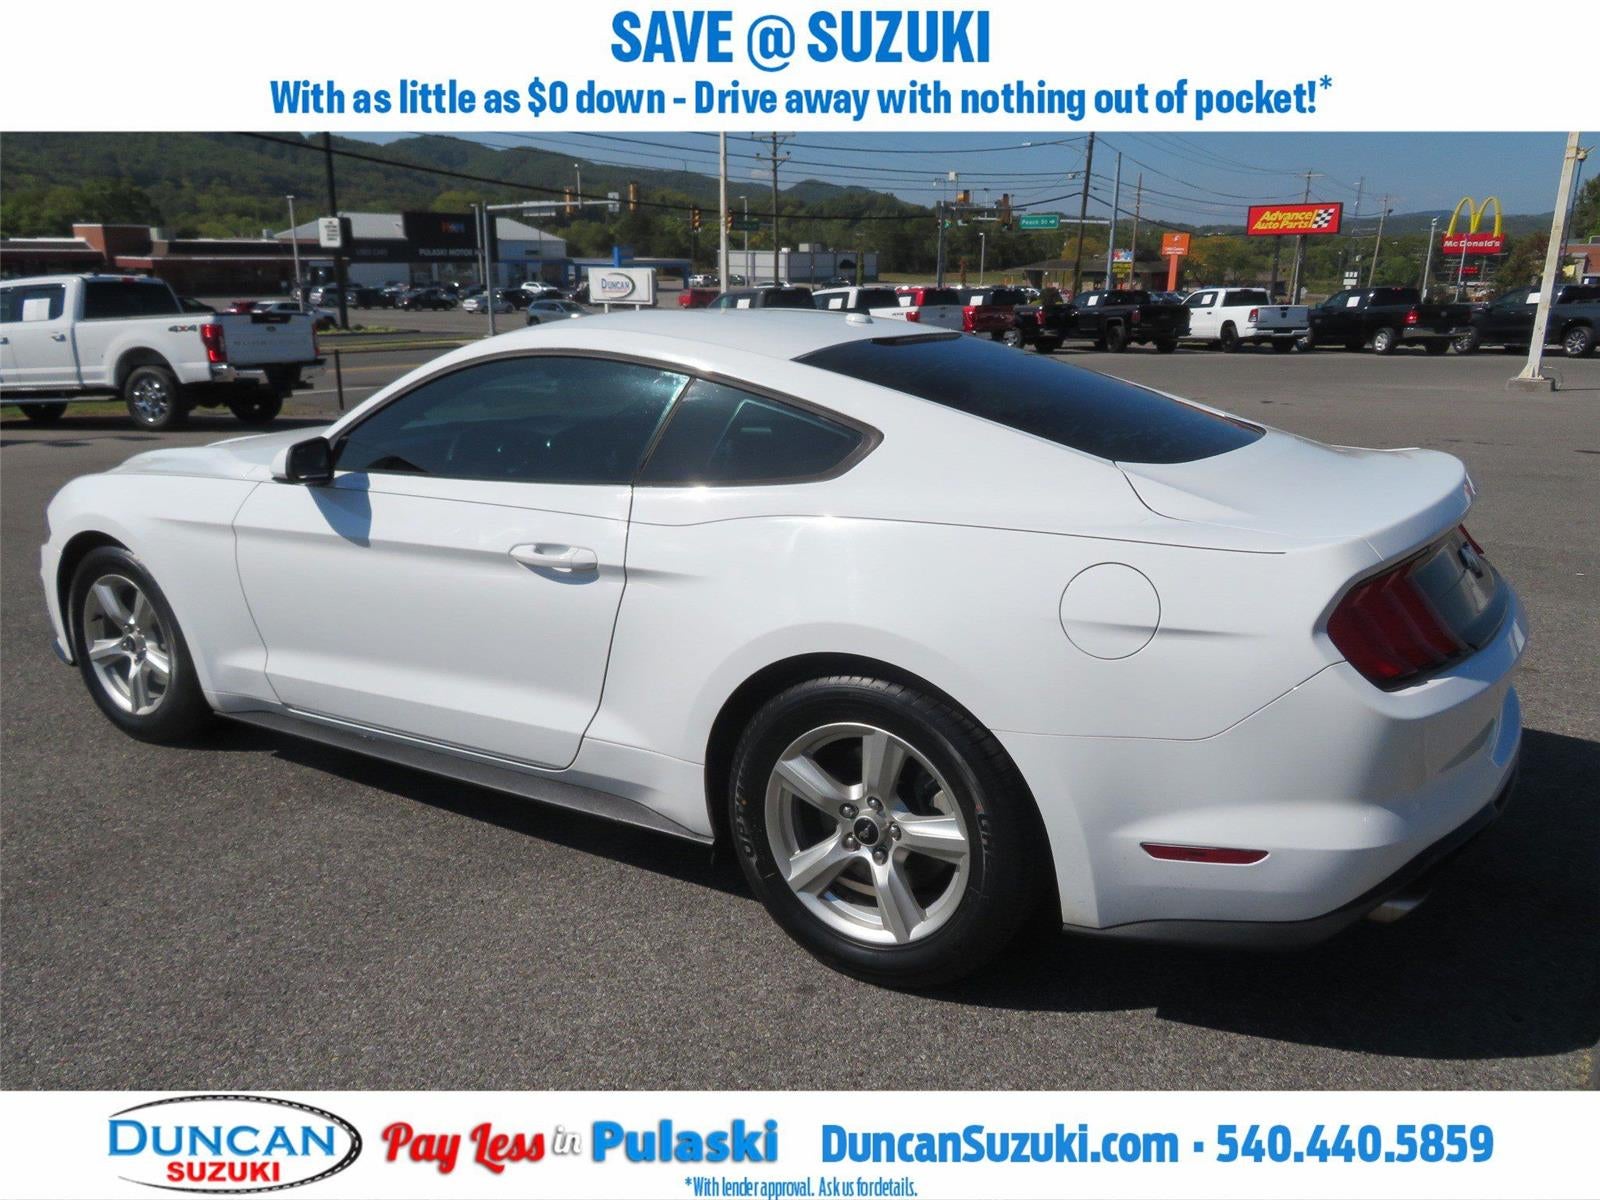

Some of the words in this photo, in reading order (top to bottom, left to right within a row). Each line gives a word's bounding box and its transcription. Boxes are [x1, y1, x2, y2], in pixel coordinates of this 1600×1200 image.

[1260, 210, 1313, 222] Advance
[1252, 220, 1279, 230] Auto
[1280, 219, 1309, 229] Parts
[1443, 240, 1501, 248] McDonald's
[601, 278, 630, 290] DUNCAN
